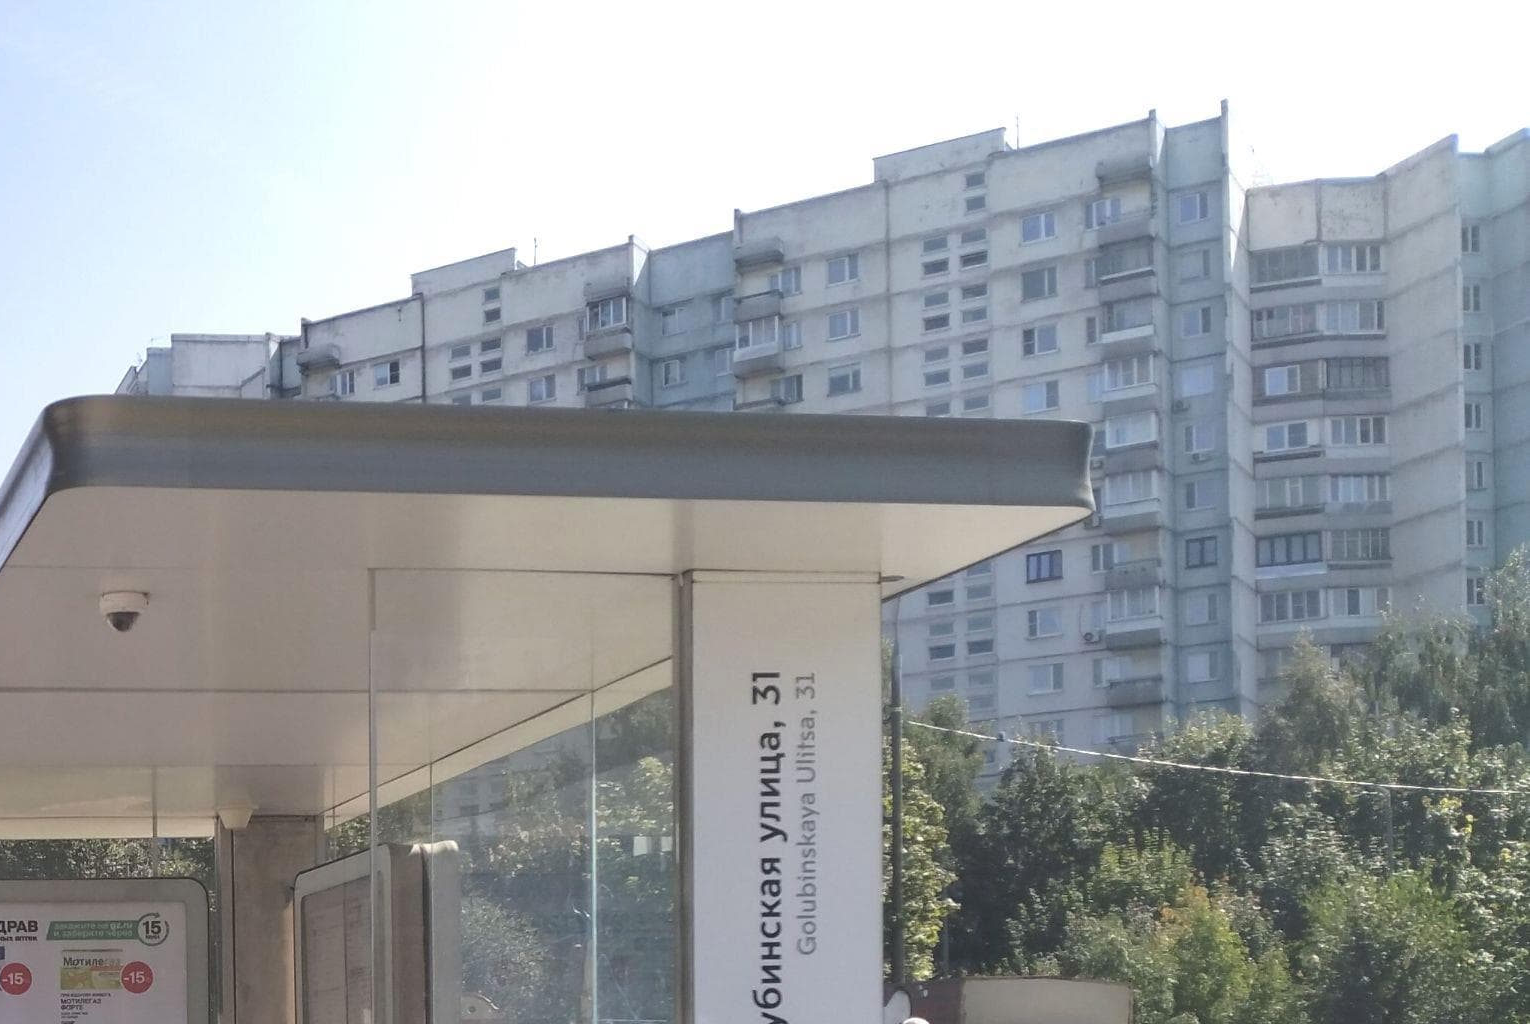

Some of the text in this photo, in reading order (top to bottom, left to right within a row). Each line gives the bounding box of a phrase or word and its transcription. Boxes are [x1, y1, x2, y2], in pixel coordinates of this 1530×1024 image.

[752, 672, 780, 705] 31
[759, 721, 788, 842] улица,
[796, 672, 820, 955] Golubinskaya Ulitsa, 31
[143, 920, 162, 936] 15
